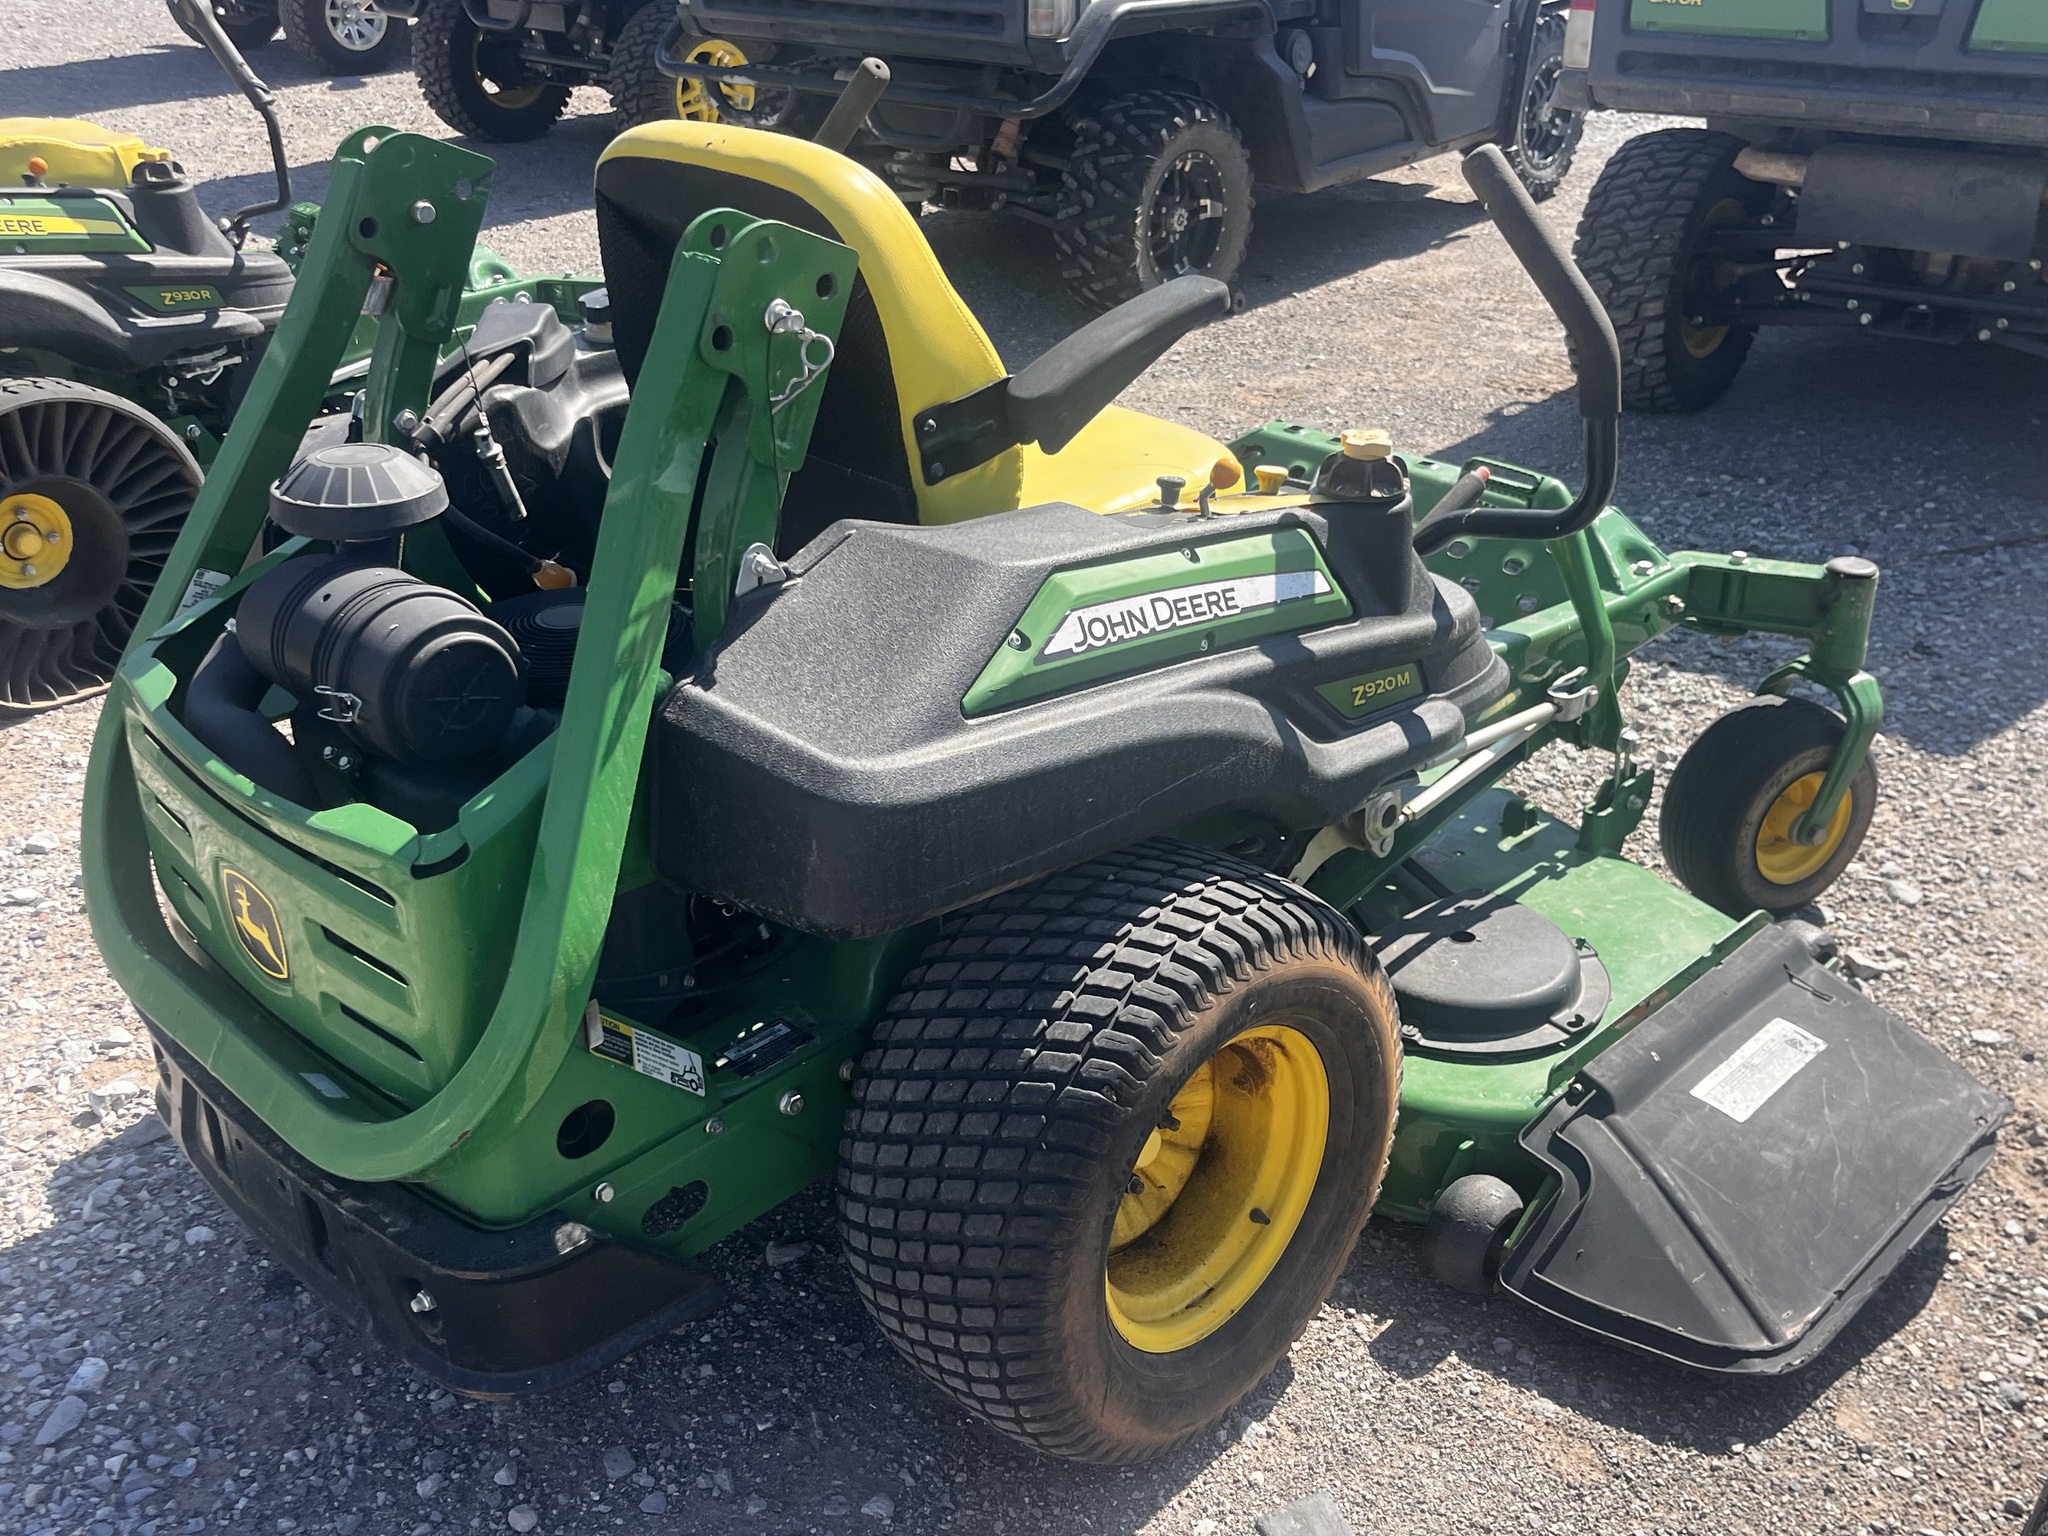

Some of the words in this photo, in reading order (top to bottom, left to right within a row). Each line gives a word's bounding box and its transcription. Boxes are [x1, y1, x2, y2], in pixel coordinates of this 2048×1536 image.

[160, 289, 212, 305] Z930R
[1074, 606, 1149, 648] JOHN
[1150, 587, 1240, 627] DEERE
[1351, 670, 1411, 706] Z920M
